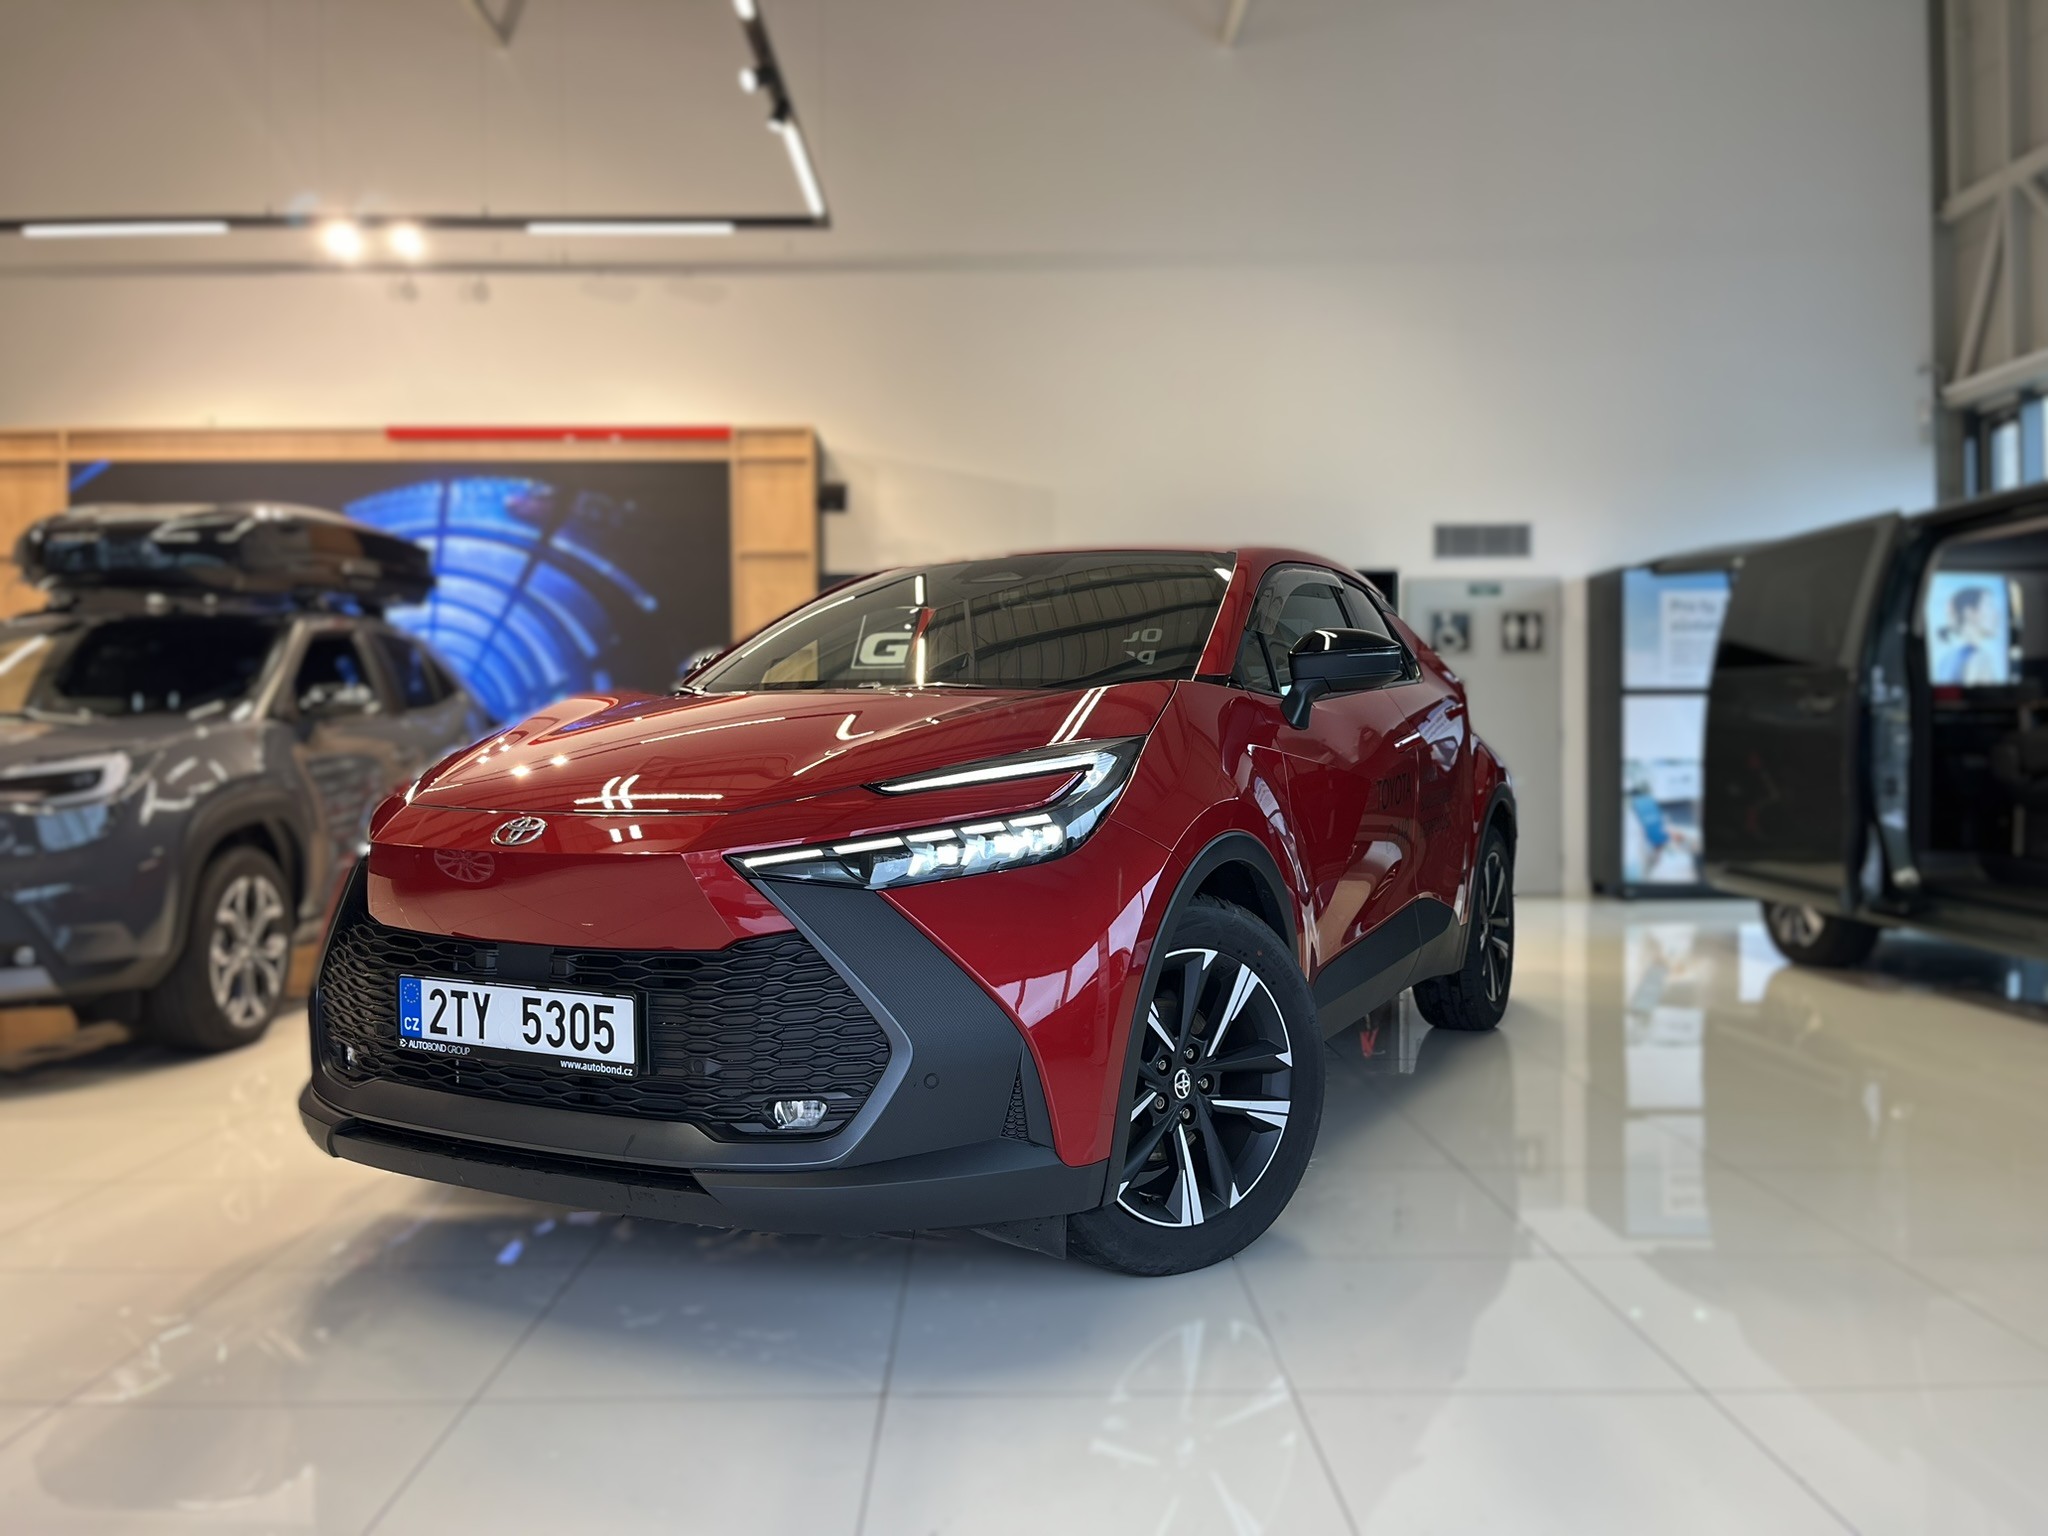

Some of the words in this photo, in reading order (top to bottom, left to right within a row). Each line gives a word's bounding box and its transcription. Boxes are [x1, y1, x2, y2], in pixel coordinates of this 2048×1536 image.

[404, 1016, 420, 1031] CZ
[429, 988, 491, 1039] 2TY
[522, 996, 614, 1055] 5305
[408, 1039, 446, 1053] AUTOBOND
[447, 1044, 470, 1055] GROUP
[560, 1060, 633, 1077] www.autobond.cz
